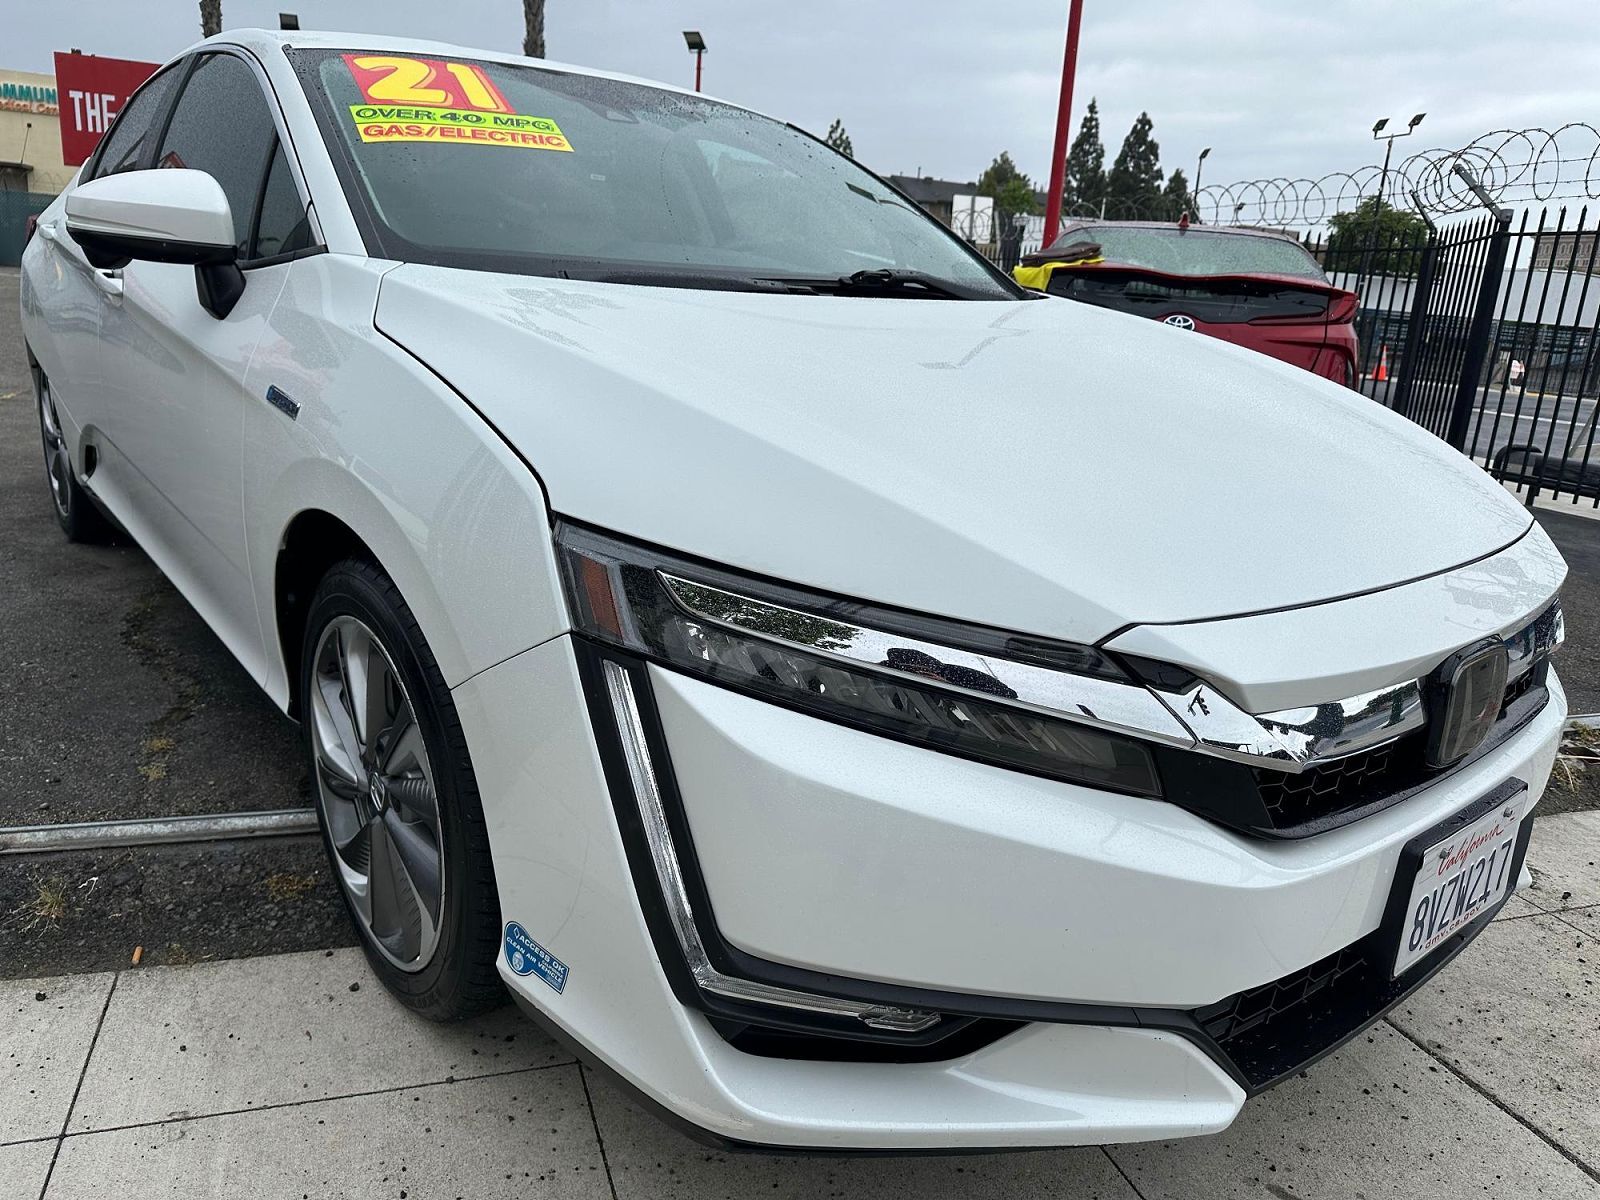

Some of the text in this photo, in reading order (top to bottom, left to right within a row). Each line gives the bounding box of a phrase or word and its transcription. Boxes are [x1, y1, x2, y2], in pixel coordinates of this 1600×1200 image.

[0, 83, 57, 104] MMUN
[353, 56, 502, 111] 21
[69, 90, 117, 133] THE
[356, 107, 555, 130] OVER 40 MPG
[363, 124, 566, 147] GAS/ELECTRIC
[1437, 820, 1505, 876] California
[1408, 838, 1514, 952] 8VZW217
[1425, 904, 1482, 949] dmv.ca.gov
[506, 936, 526, 954] CLEAN
[526, 952, 537, 963] AIR
[538, 961, 563, 983] VEHICLE
[519, 935, 565, 974] ACCESS OK
